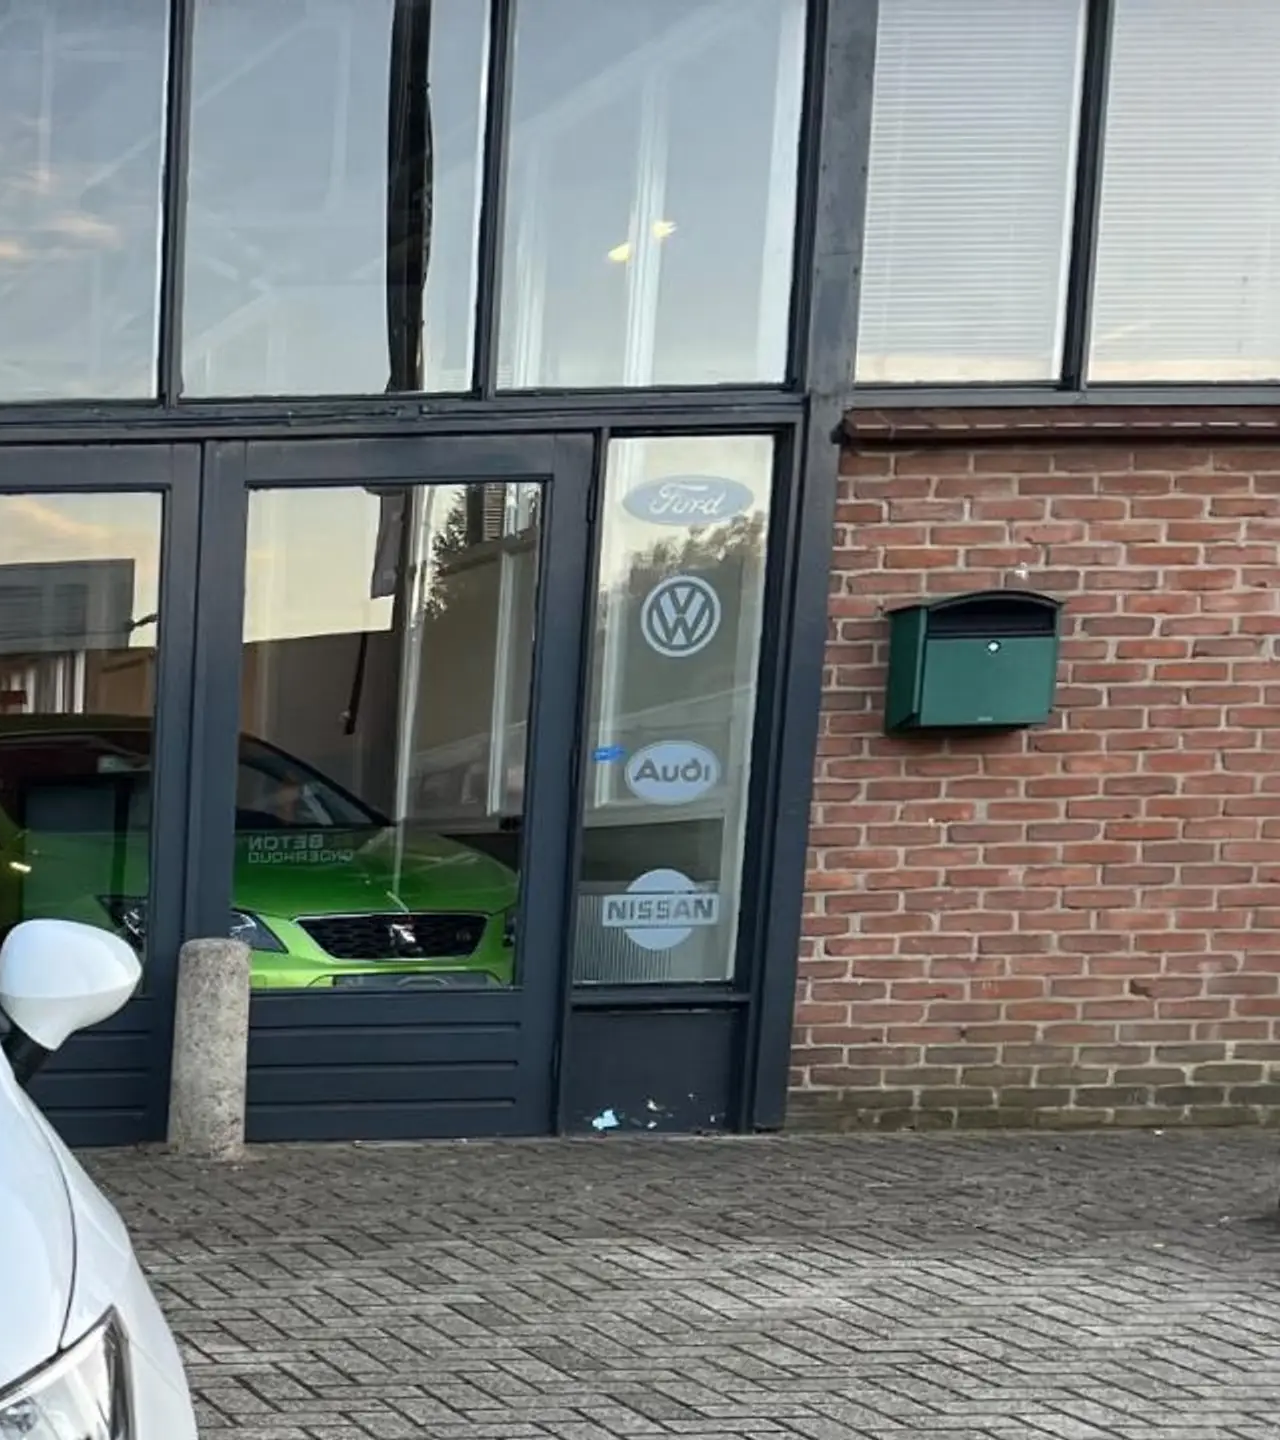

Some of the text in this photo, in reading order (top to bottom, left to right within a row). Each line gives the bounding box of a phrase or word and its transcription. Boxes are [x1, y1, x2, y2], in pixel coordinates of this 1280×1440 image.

[649, 482, 726, 515] Ford
[633, 758, 710, 783] Audi
[608, 898, 714, 920] NISSAN
